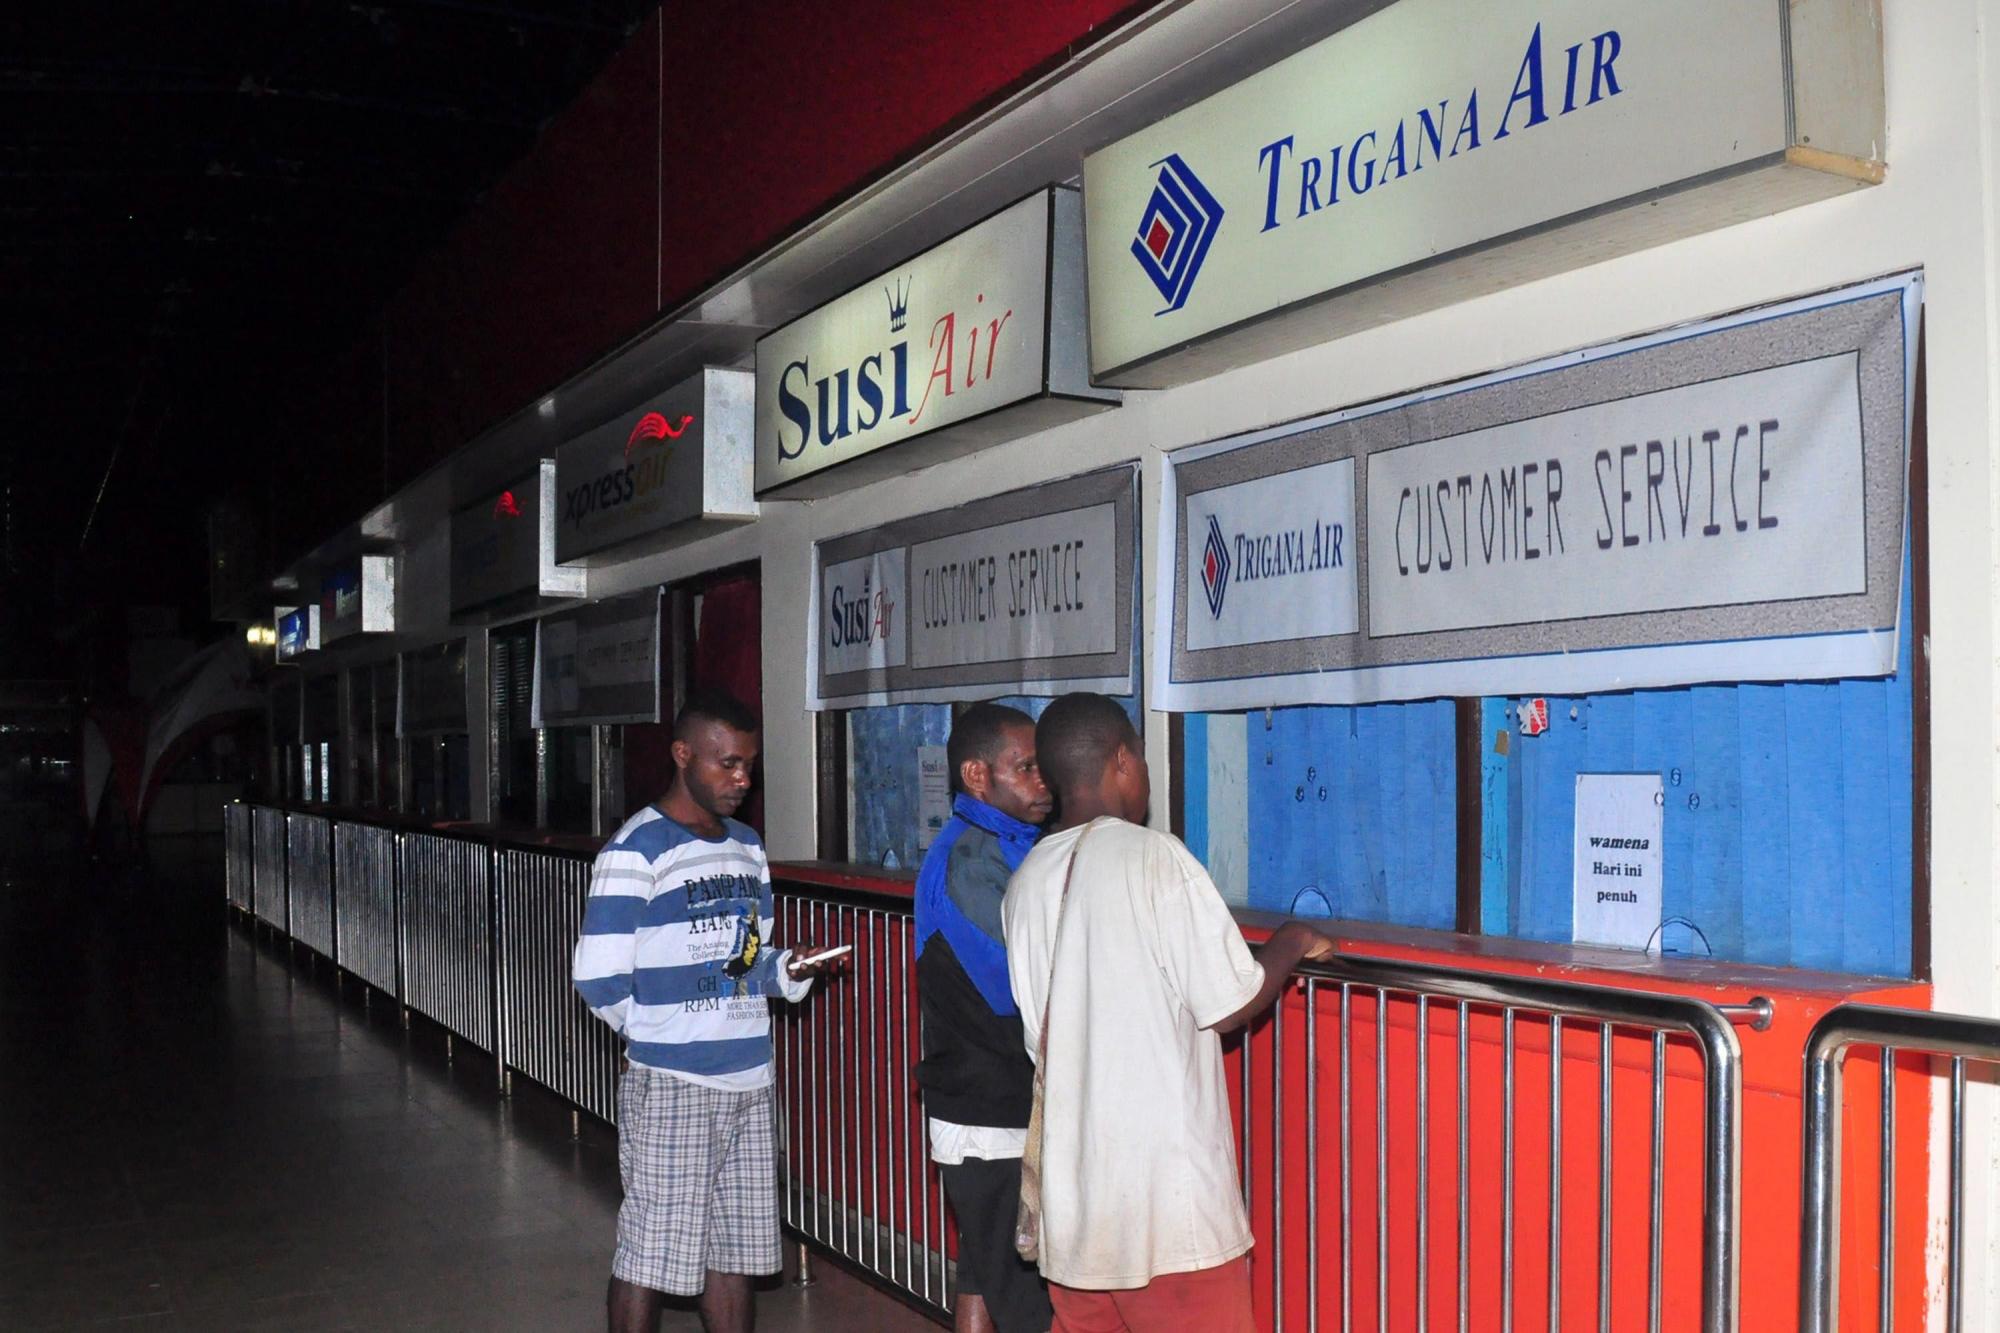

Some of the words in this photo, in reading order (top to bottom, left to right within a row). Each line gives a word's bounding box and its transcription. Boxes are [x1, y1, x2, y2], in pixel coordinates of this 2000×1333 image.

[1258, 88, 1482, 235] TRIGANA
[1493, 21, 1624, 141] AIR
[777, 340, 914, 465] Susi
[908, 294, 1013, 425] Air
[1395, 456, 1566, 577] CUSTOMER
[1594, 418, 1780, 551] SERVICE
[1234, 528, 1307, 584] TRIGANA
[1308, 518, 1344, 573] AIR
[830, 584, 871, 649] Susi
[869, 587, 895, 648] Air
[922, 555, 997, 630] CUSTOMER
[1008, 539, 1085, 618] SERVICE
[1590, 837, 1649, 850] wamena
[1593, 862, 1621, 875] Hari
[1624, 863, 1642, 877] ini
[1597, 890, 1637, 903] penuh
[685, 997, 720, 1013] RPM
